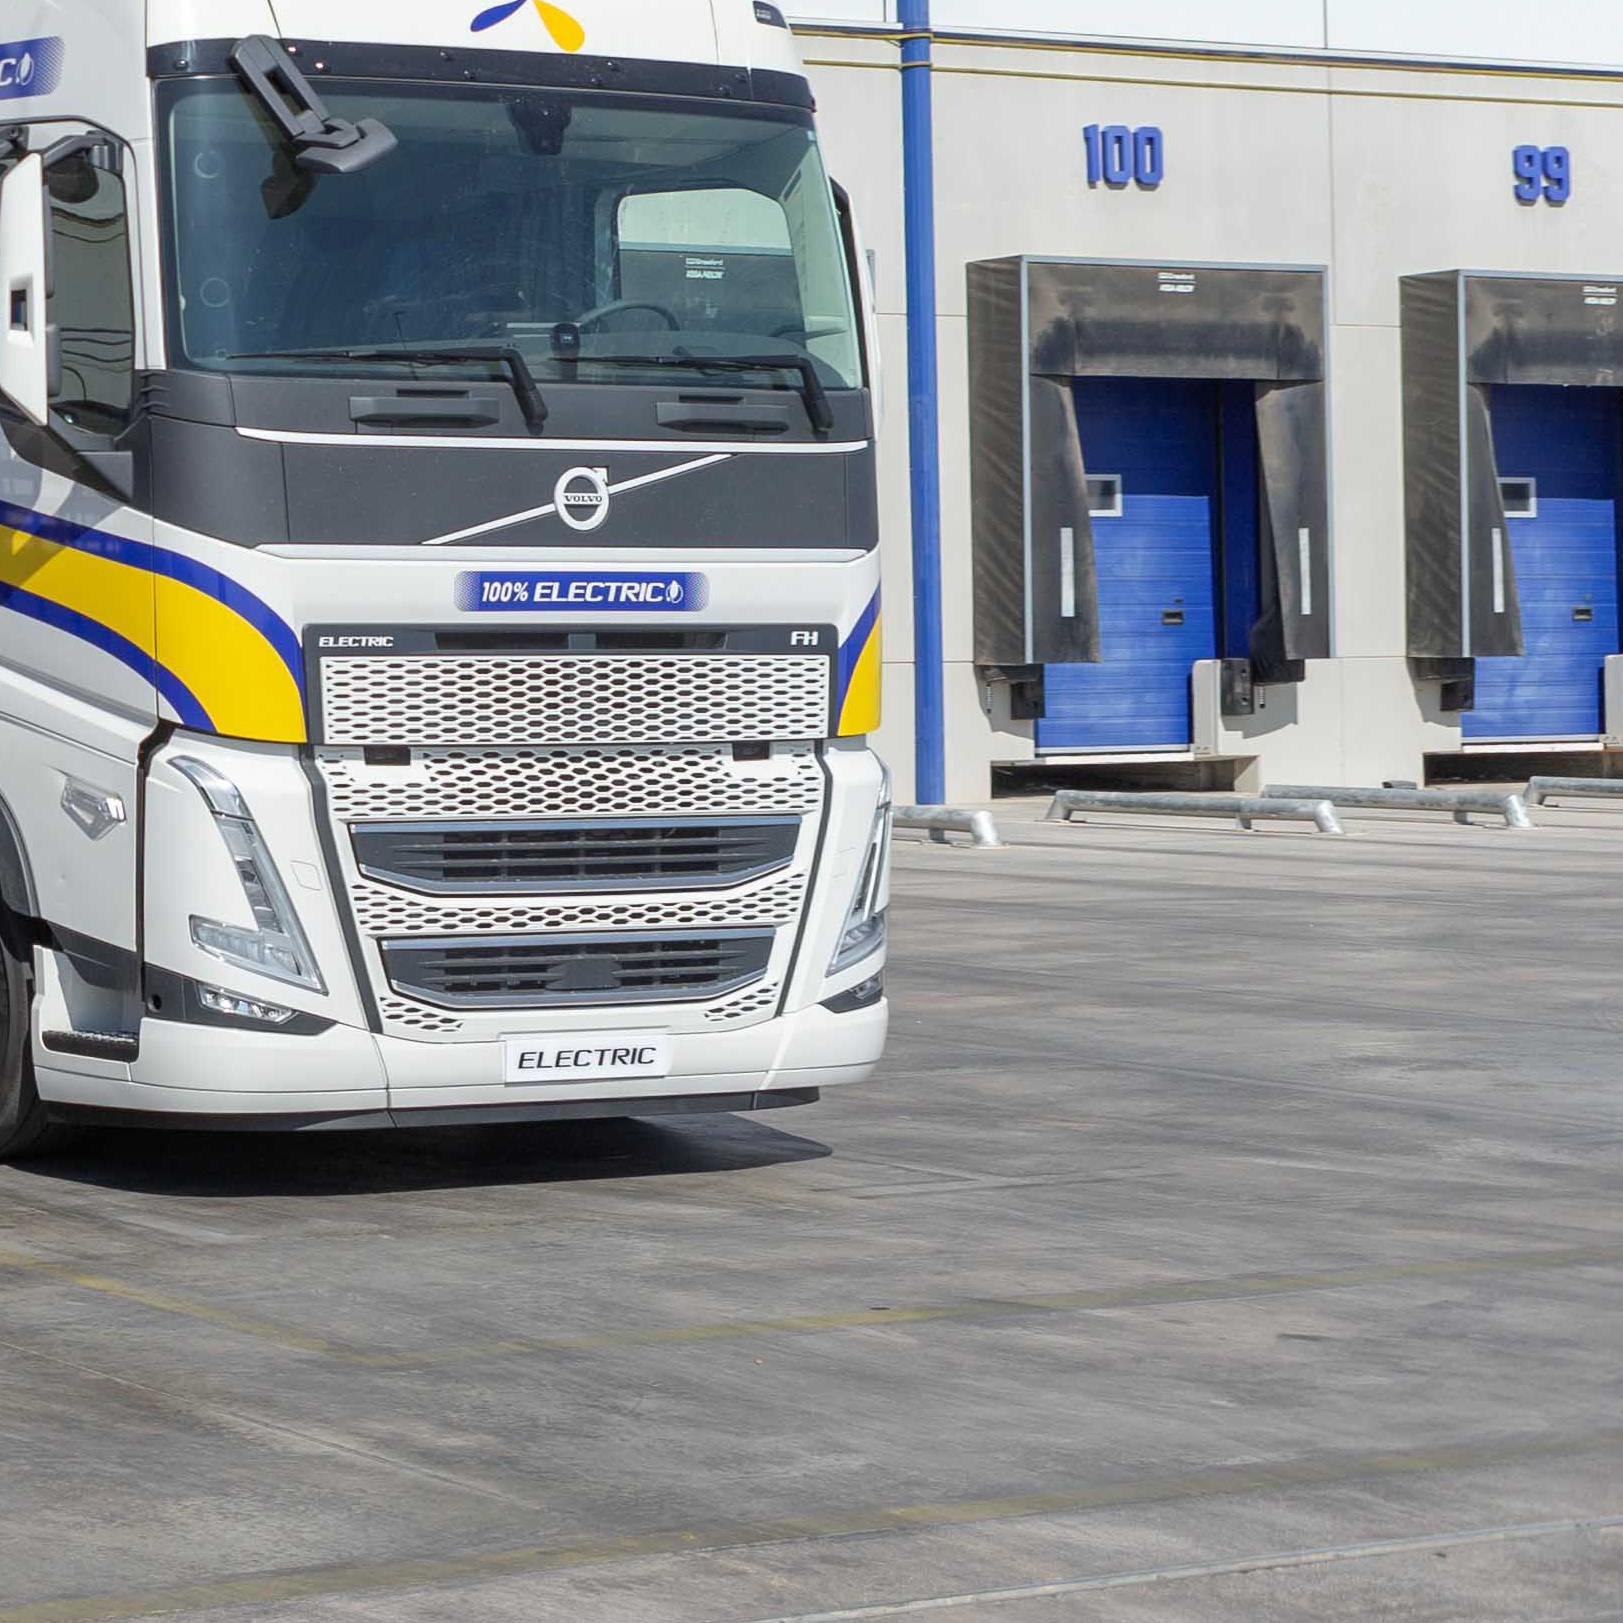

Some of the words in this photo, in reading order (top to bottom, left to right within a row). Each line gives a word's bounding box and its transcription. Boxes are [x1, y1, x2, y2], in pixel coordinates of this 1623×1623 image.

[1082, 124, 1164, 186] 100
[1512, 145, 1570, 202] 99
[564, 495, 603, 503] VOLVO
[482, 581, 529, 603] 100%
[533, 581, 665, 603] ELECTRIC
[319, 636, 394, 648] ELECTRIC
[790, 631, 819, 645] FH
[518, 1047, 657, 1069] ELECTRIC
